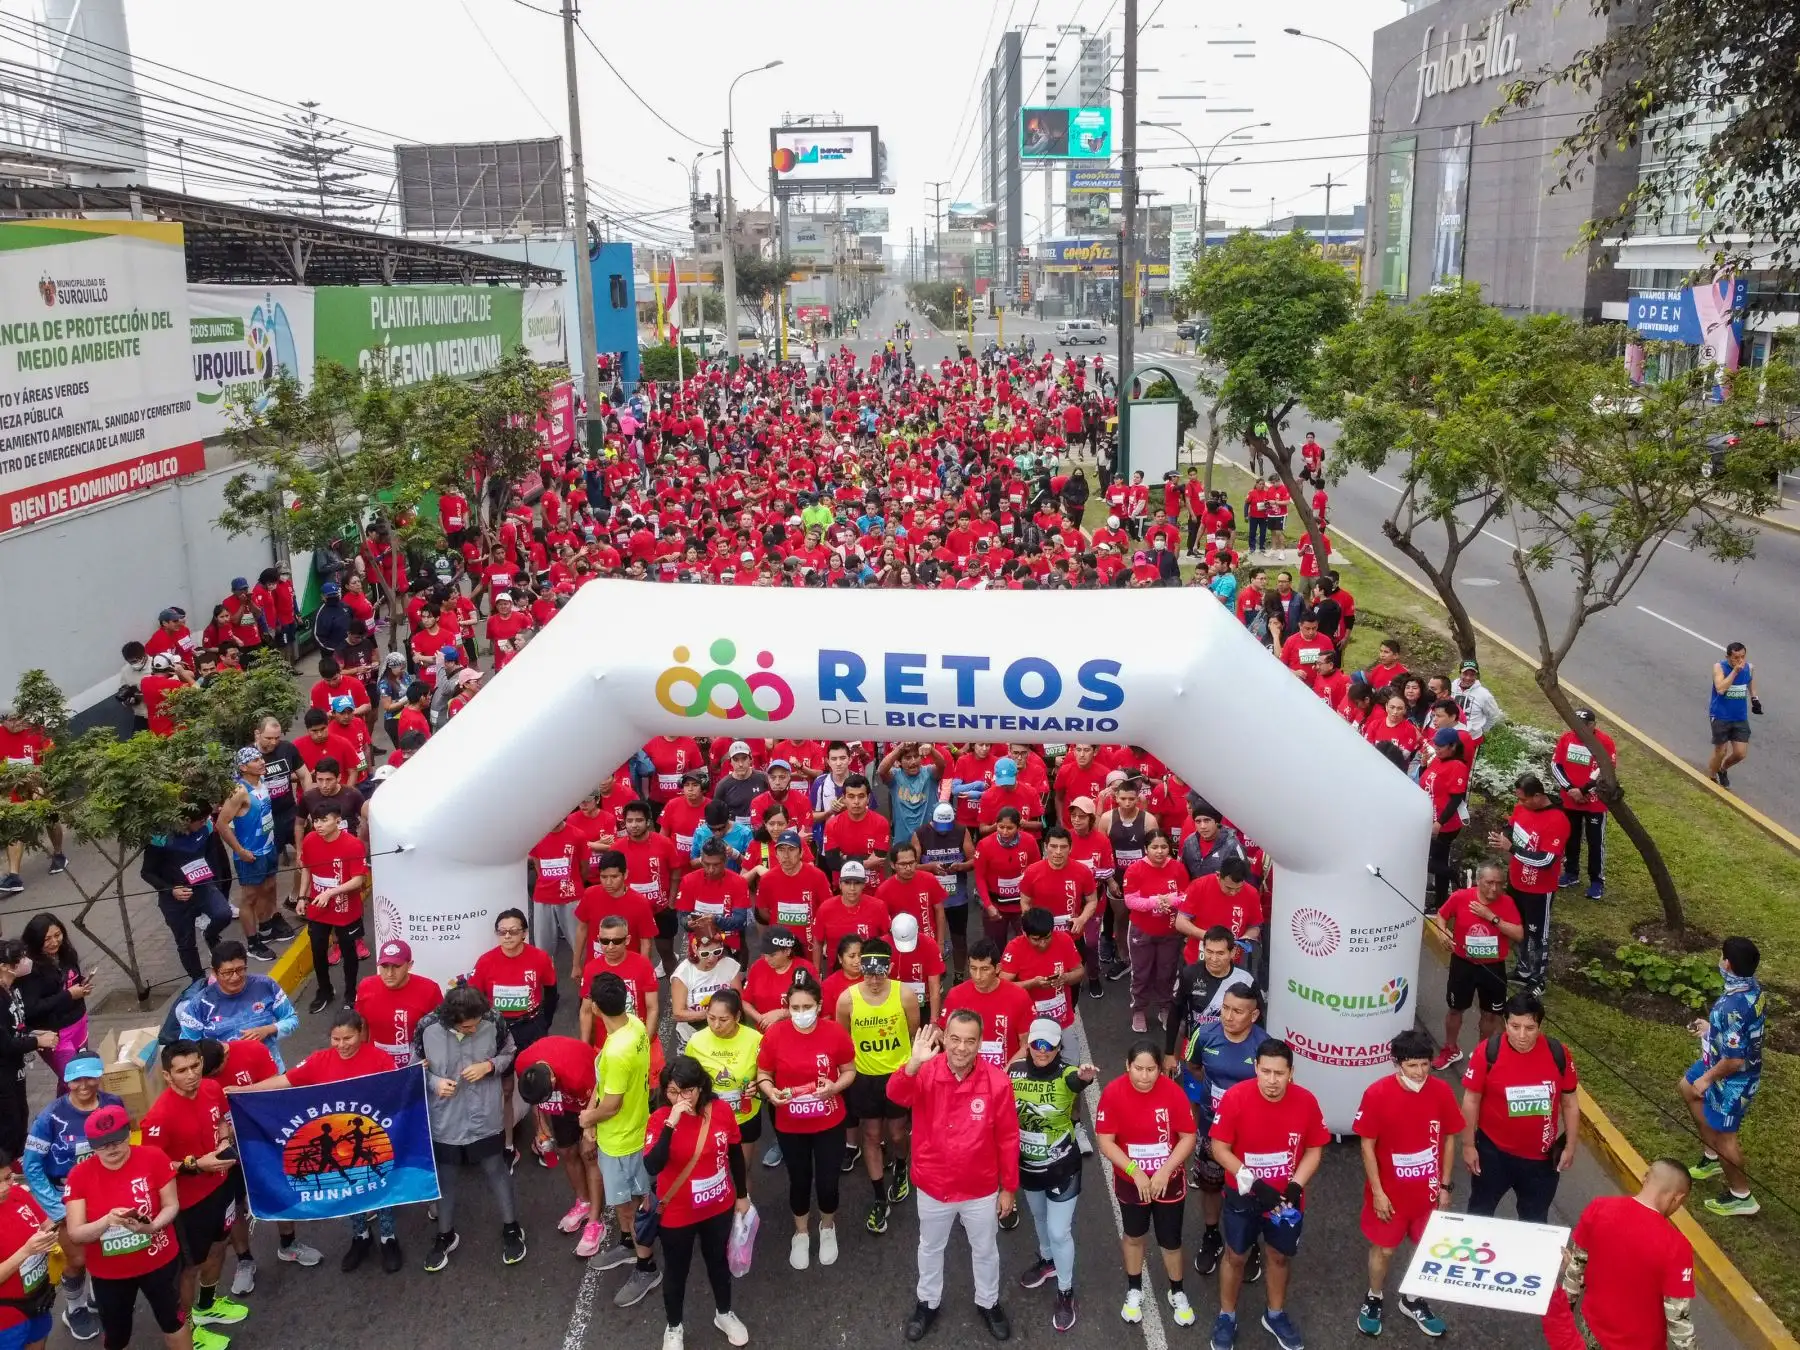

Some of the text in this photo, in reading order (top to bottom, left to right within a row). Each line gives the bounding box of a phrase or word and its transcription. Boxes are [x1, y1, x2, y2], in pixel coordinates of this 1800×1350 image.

[1441, 213, 1461, 226] Denim
[57, 278, 106, 288] MUNICIPALIDAD DE
[58, 286, 108, 305] SURQUILLO
[1639, 291, 1665, 301] VIVAMOS
[371, 294, 492, 330] PLANTA MUNICIPAL DE
[1638, 305, 1682, 321] OPEN
[0, 306, 173, 346] NCIA DE PROTECCIÓN DEL
[209, 323, 235, 338] JUNTOS
[17, 338, 141, 372] MEDIO AMBIENTE
[14, 392, 20, 406] Y
[22, 387, 53, 405] ÁREAS
[55, 381, 90, 399] VERDES
[24, 406, 64, 426] PÚBLICA
[52, 419, 104, 442] AMBIENTAL,
[105, 410, 140, 430] SANIDAD
[140, 409, 147, 421] Y
[147, 400, 191, 421] CEMENTERIO
[24, 453, 37, 471] DE
[38, 440, 96, 465] EMERGENCIA
[96, 436, 108, 451] DE
[109, 434, 119, 447] LA
[120, 427, 145, 444] MUJER
[11, 456, 179, 526] BIEN DE DOMINIO PÚBLICO
[817, 648, 1125, 712] RETOS
[821, 707, 1119, 733] DEL BICENTENARIO
[926, 847, 961, 856] REBELDES
[189, 866, 212, 881] 00312
[542, 867, 569, 877] 00333
[1065, 880, 1074, 891] 21
[409, 909, 488, 923] BICENTENARIO
[778, 912, 808, 923] 00759
[1232, 906, 1242, 917] 21
[409, 922, 460, 932] DEL PERÚ
[857, 924, 866, 934] 21
[1350, 916, 1417, 935] BICENTENARIO
[1373, 933, 1399, 943] PERÚ
[1377, 943, 1397, 952] 2024
[1466, 945, 1498, 956] 00834
[524, 970, 534, 982] 21
[494, 997, 527, 1008] 00741
[394, 1009, 404, 1022] 21
[854, 1016, 889, 1027] Achilles
[995, 1014, 1004, 1027] 21
[860, 1037, 901, 1053] GUIA
[710, 1050, 734, 1058] Achilles
[1294, 1047, 1313, 1060] DEL
[816, 1054, 827, 1068] 21
[235, 1070, 248, 1086] 21
[1009, 1071, 1028, 1079] TEAM
[1039, 1093, 1056, 1104] ATE
[789, 1101, 824, 1114] 00676
[1510, 1100, 1550, 1113] 00778
[1155, 1108, 1166, 1123] 21
[275, 1100, 393, 1146] SAN BARTOLO
[1430, 1120, 1440, 1134] 21
[1288, 1132, 1298, 1146] 21
[1396, 1163, 1435, 1178] 00672
[131, 1177, 145, 1195] 21
[300, 1177, 387, 1203] RUNNERS
[694, 1182, 728, 1204] 00384
[103, 1233, 150, 1252] 00881
[1420, 1260, 1542, 1289] RETOS
[1418, 1274, 1537, 1297] DEL BICENTENARIO
